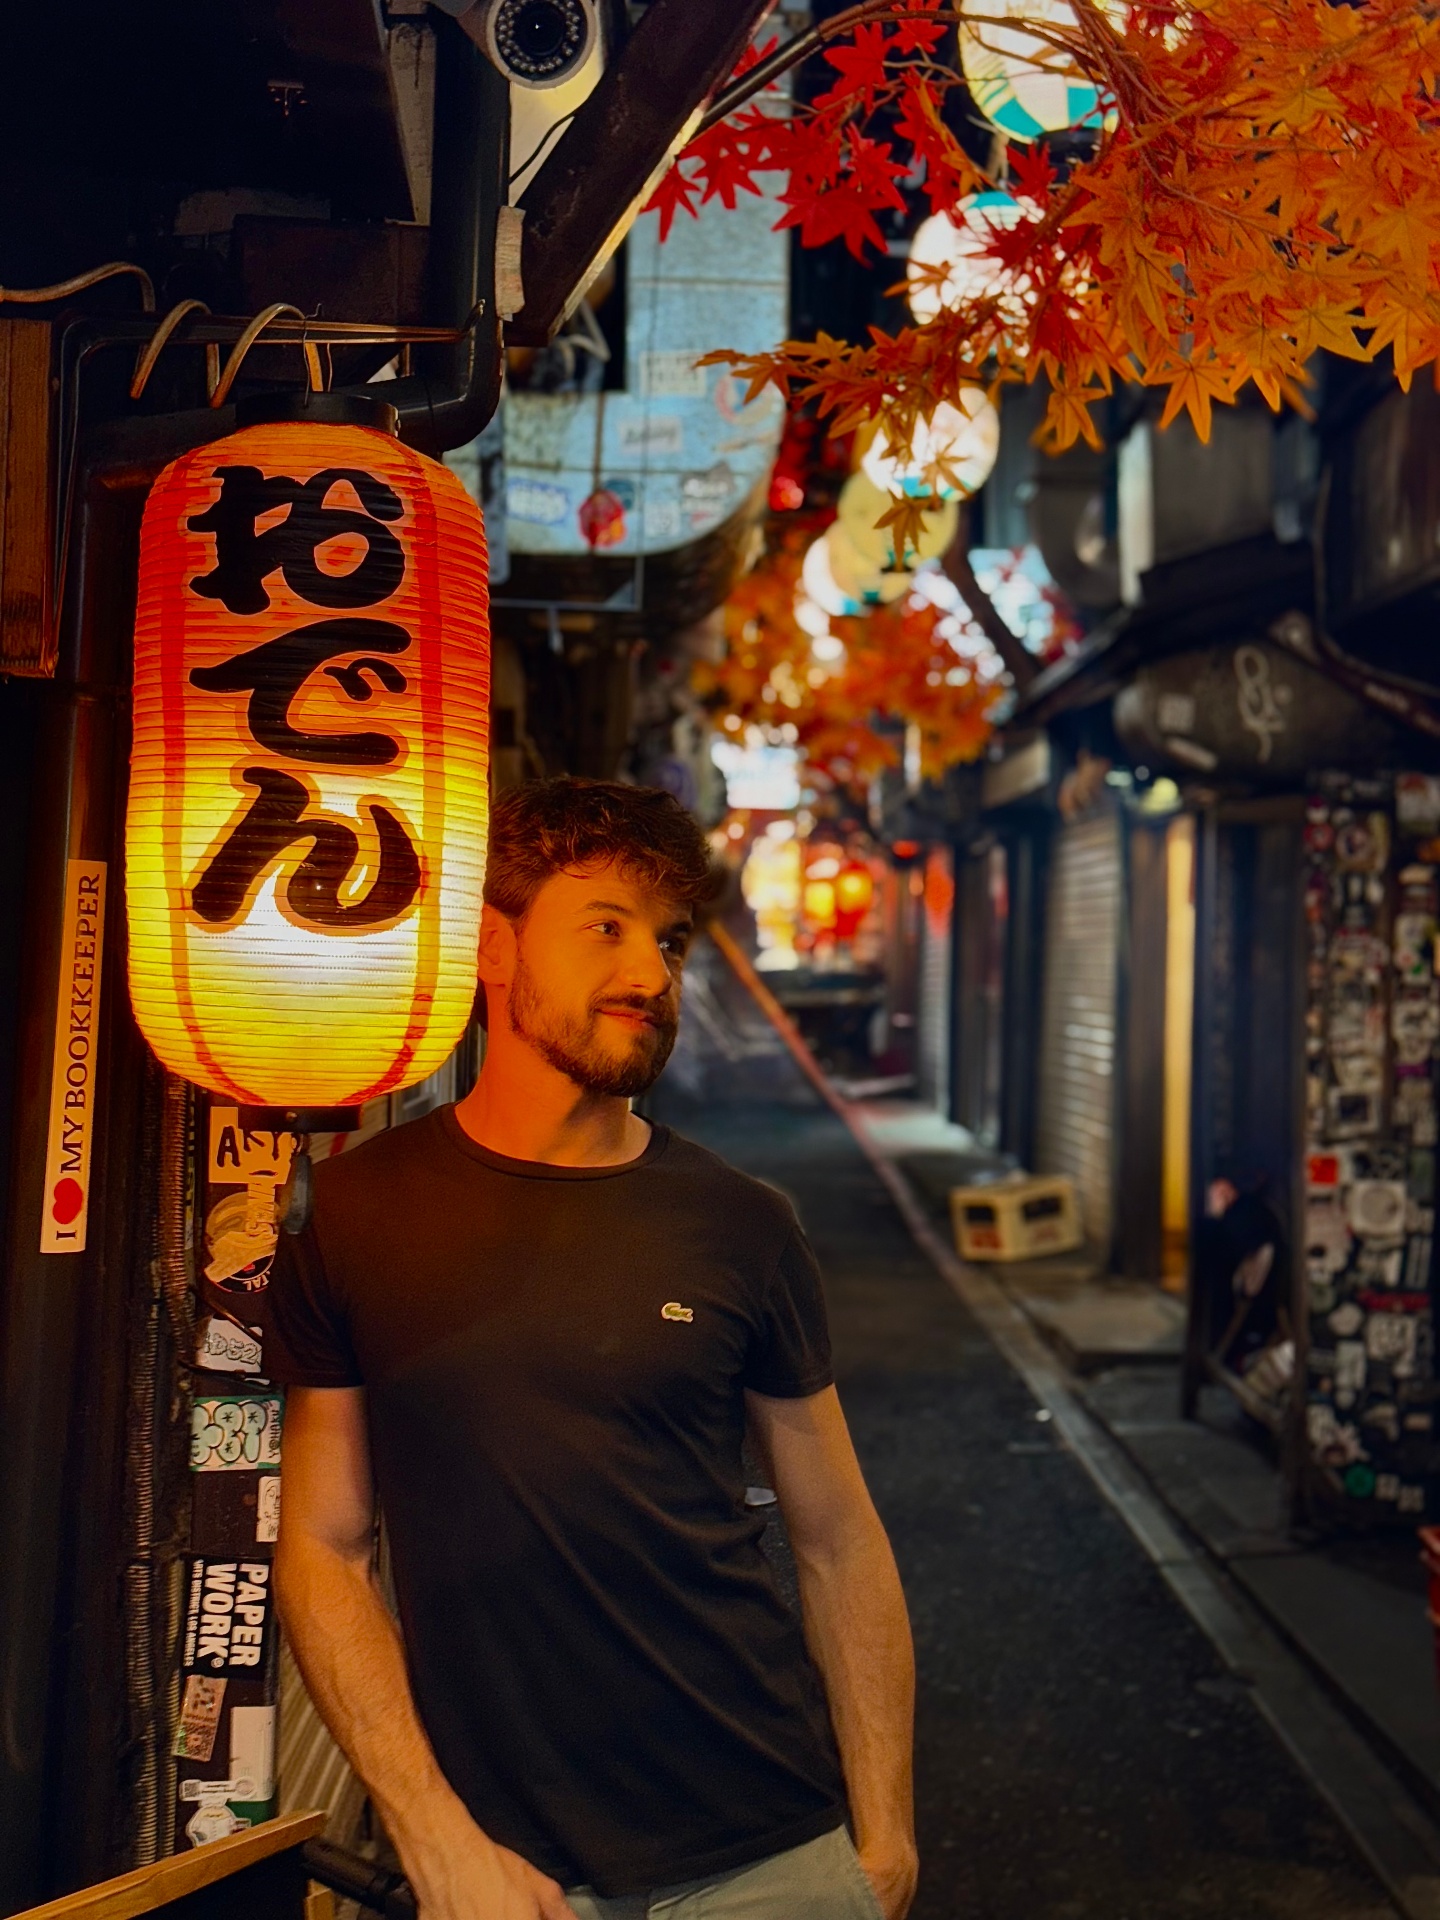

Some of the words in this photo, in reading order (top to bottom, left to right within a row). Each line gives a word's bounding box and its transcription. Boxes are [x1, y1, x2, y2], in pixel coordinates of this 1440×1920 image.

[186, 465, 421, 926] おでん
[64, 873, 101, 1110] BOOKKEEPER
[60, 1114, 84, 1173] MY
[56, 1230, 77, 1240] I
[187, 1616, 199, 1631] LOS
[229, 1563, 269, 1667] PAPER
